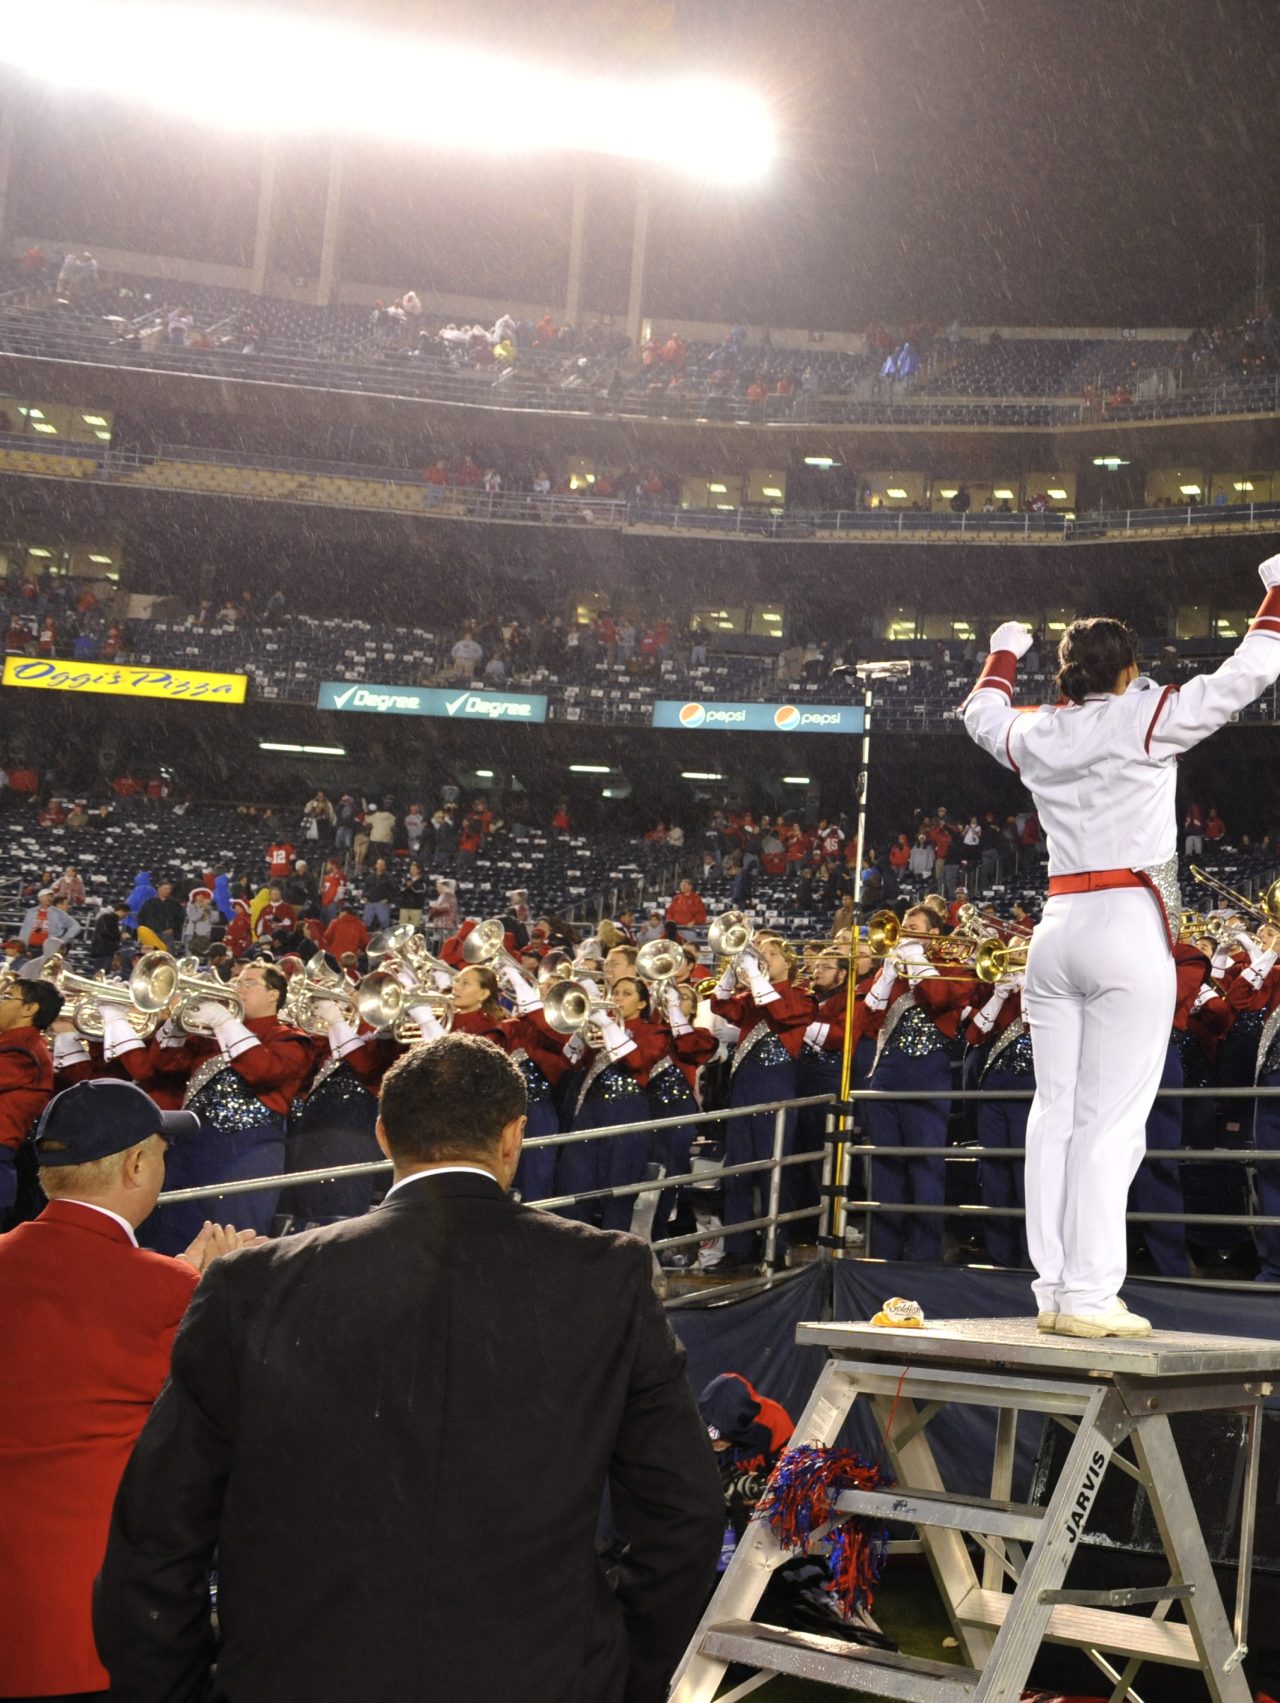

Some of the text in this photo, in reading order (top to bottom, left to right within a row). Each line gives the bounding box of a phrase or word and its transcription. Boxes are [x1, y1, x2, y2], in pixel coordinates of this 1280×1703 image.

[13, 661, 232, 697] Oggi's Pizza
[353, 690, 532, 718] Degree Degree
[706, 709, 841, 727] pepsi pepsi
[273, 850, 286, 864] 12
[1066, 1451, 1105, 1544] JARVIS
